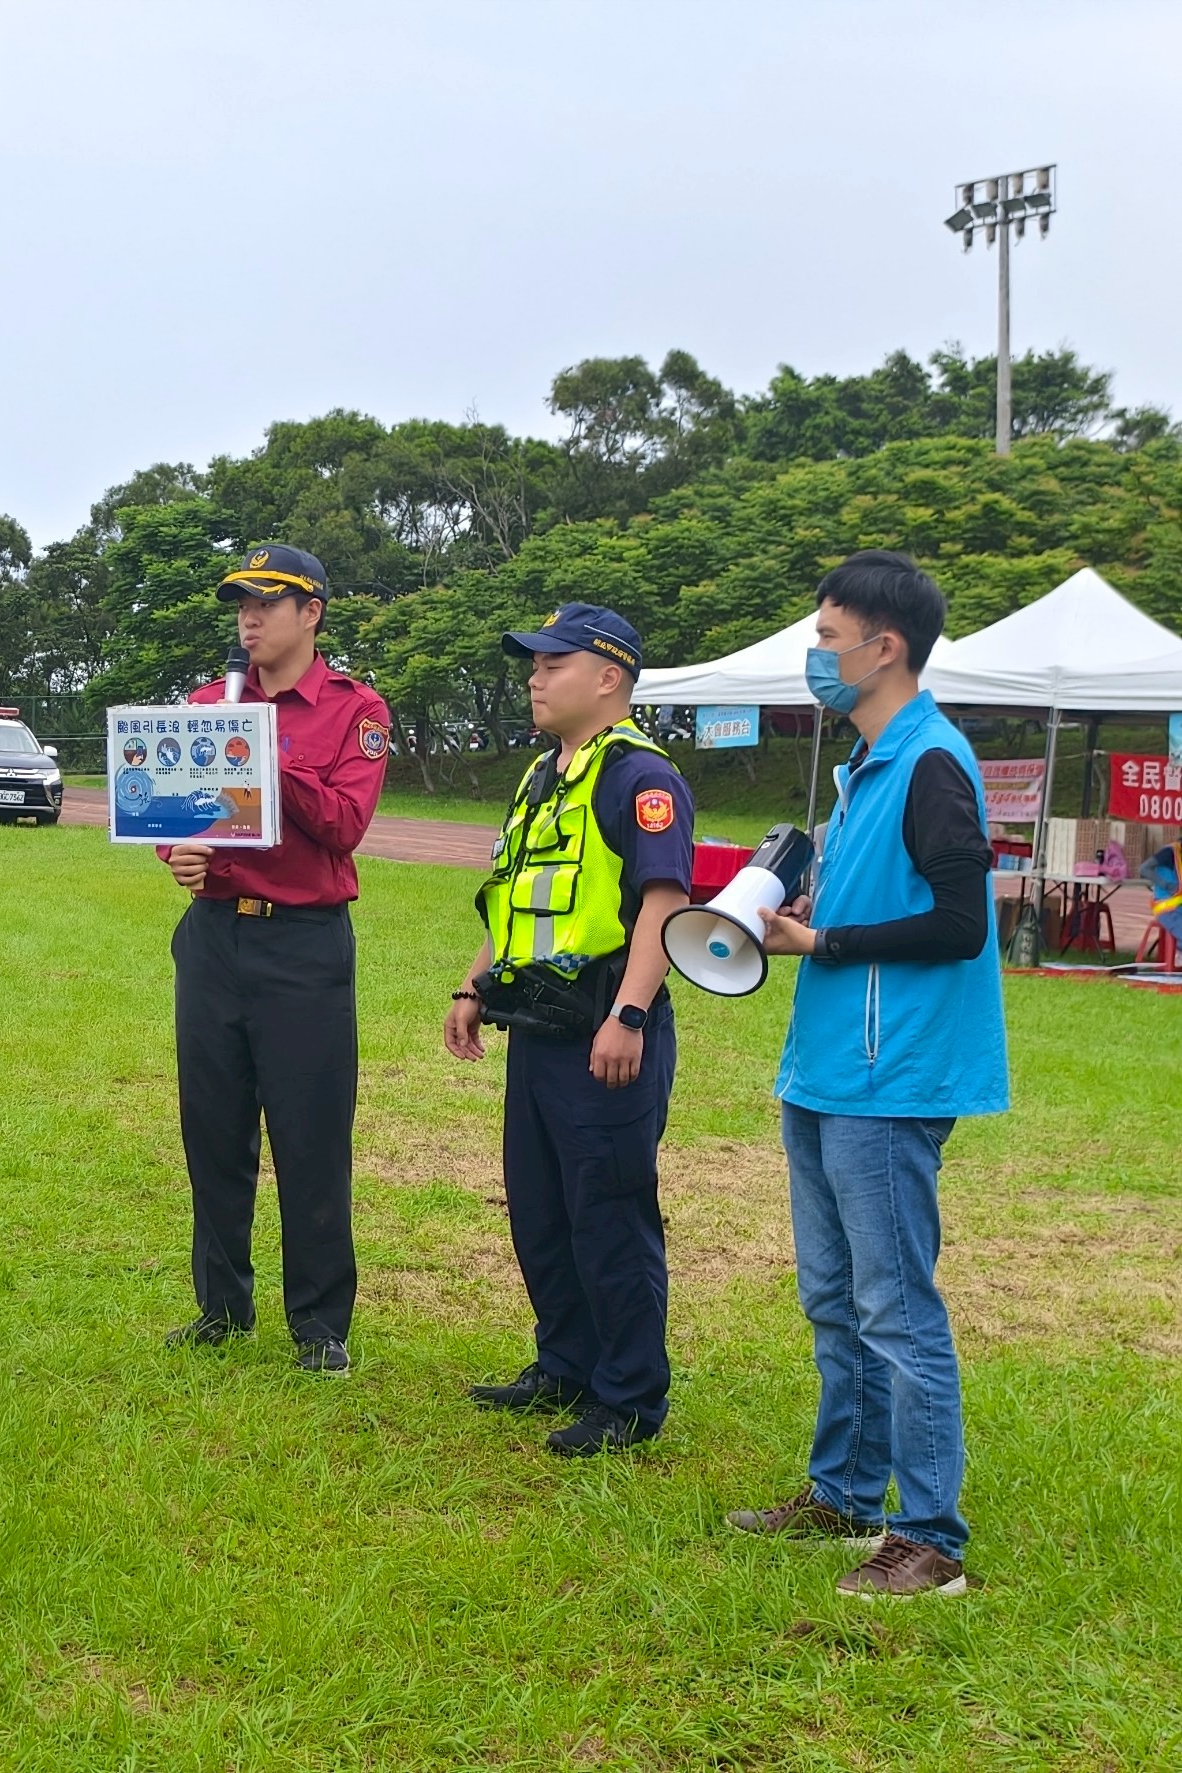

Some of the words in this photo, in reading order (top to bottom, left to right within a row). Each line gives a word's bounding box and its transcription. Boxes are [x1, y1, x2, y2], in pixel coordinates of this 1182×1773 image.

[117, 719, 180, 734] 颱風引長浪
[187, 718, 253, 733] 輕忽易傷亡
[704, 718, 751, 738] 大會服務台
